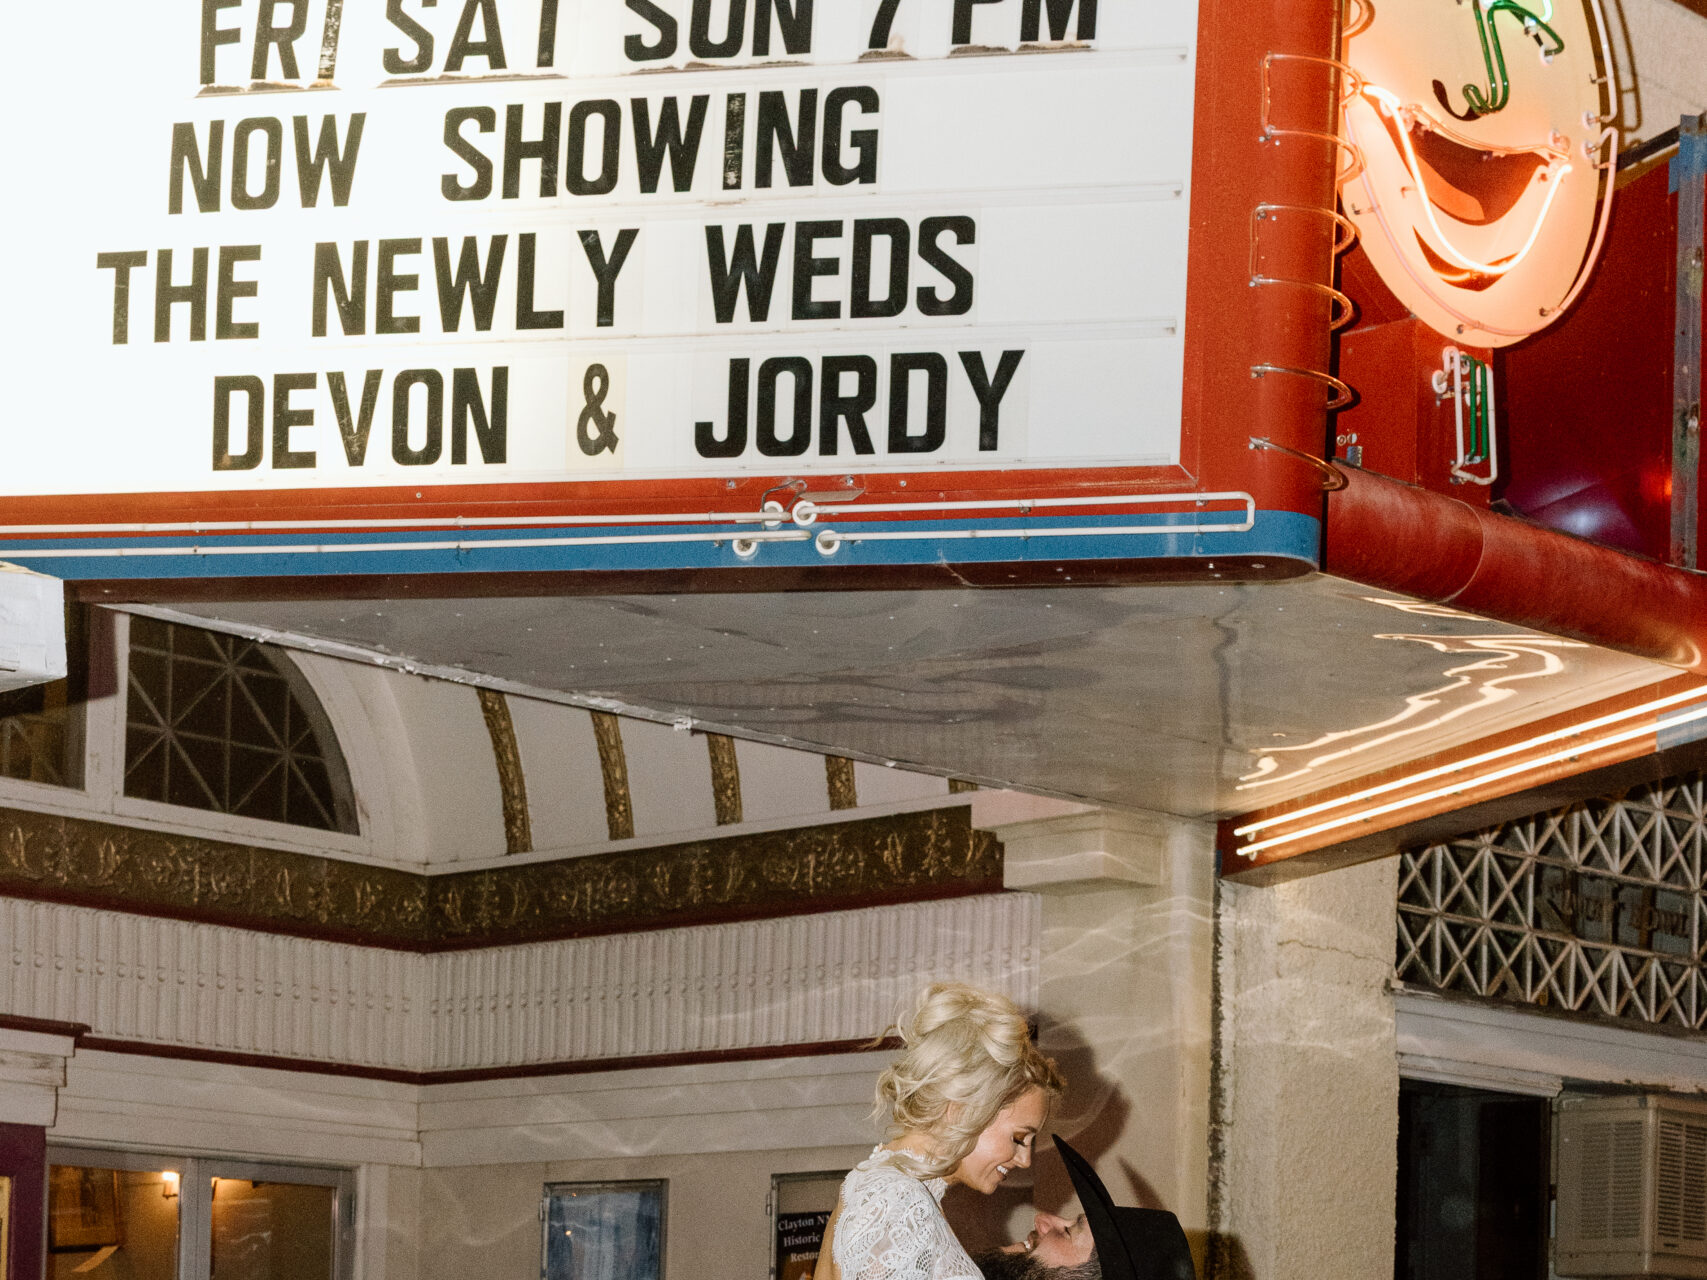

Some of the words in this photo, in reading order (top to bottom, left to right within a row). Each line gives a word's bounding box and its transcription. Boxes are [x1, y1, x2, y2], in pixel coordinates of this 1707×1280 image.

[200, 0, 343, 84] FRI
[170, 114, 365, 214] NOW
[442, 86, 879, 201] SHOWING
[98, 246, 260, 344] THE
[313, 229, 639, 336] NEWLY
[705, 216, 975, 323] WEDS
[213, 367, 508, 470] DEVON
[577, 364, 618, 455] &
[695, 350, 1025, 458] JORDY
[778, 1218, 814, 1232] Clayton
[784, 1232, 821, 1247] Historic
